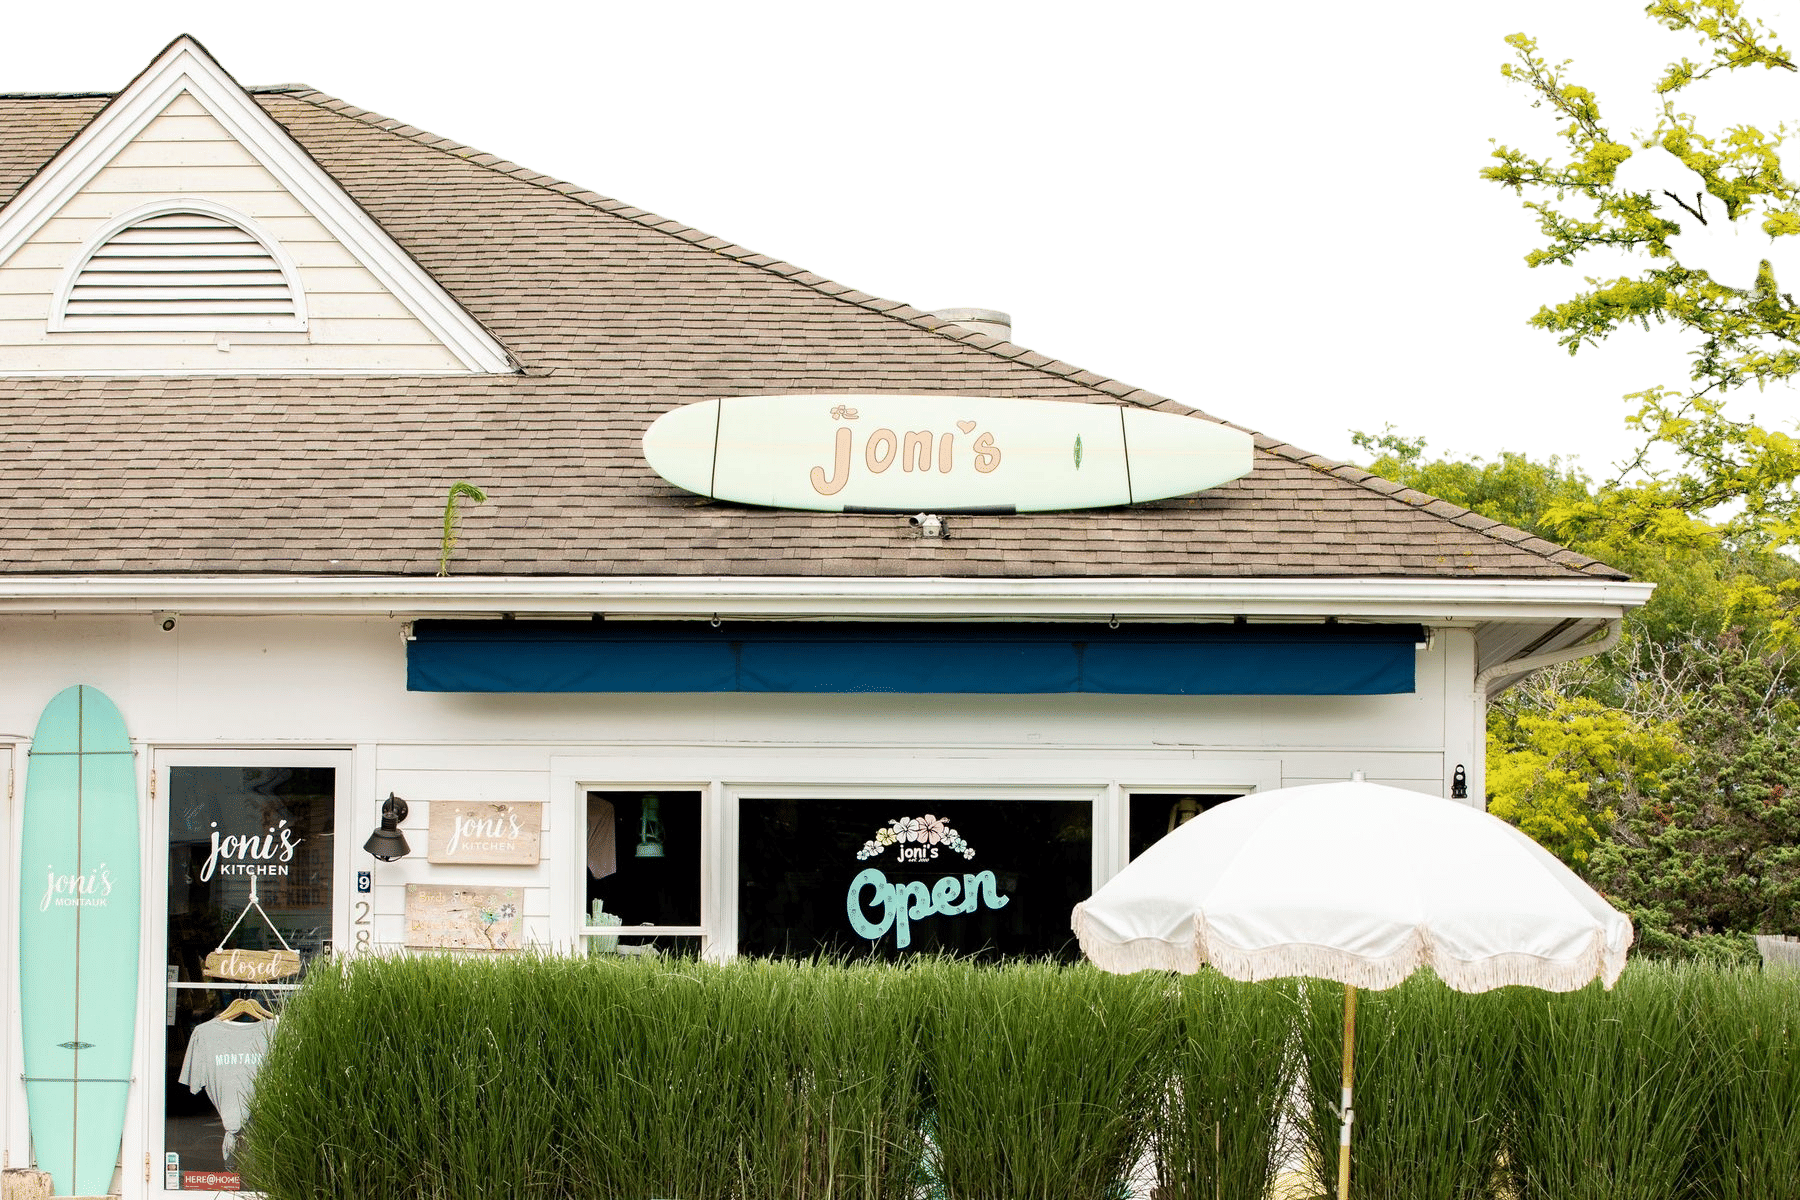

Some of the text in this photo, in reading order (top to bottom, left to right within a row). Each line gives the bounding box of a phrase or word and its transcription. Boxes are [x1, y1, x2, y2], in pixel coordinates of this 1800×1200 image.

[446, 806, 526, 855] joni's
[200, 819, 302, 882] joni's
[462, 842, 515, 850] KITCHEN
[897, 844, 939, 862] joni's
[220, 864, 289, 876] KITCHEN
[55, 898, 107, 906] MONTAUK
[847, 868, 1010, 949] Open
[220, 949, 282, 980] closed
[185, 1174, 240, 1185] HERE@HOME
